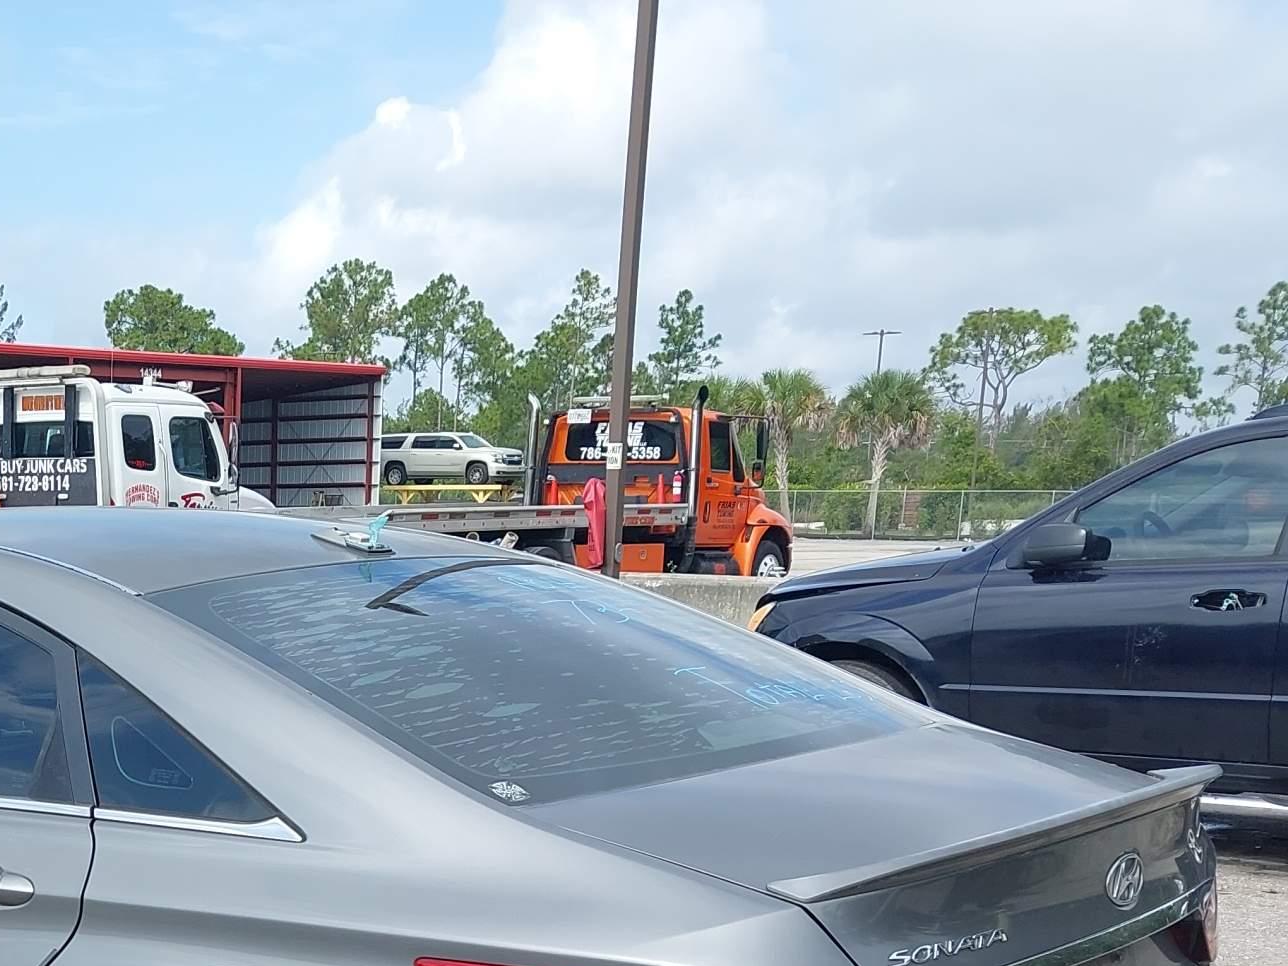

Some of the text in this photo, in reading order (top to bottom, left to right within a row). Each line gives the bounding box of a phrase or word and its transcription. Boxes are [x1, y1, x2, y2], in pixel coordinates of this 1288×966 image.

[140, 367, 162, 379] 14344
[0, 460, 24, 474] BUY
[24, 460, 54, 474] JUNK
[57, 459, 87, 473] CARS
